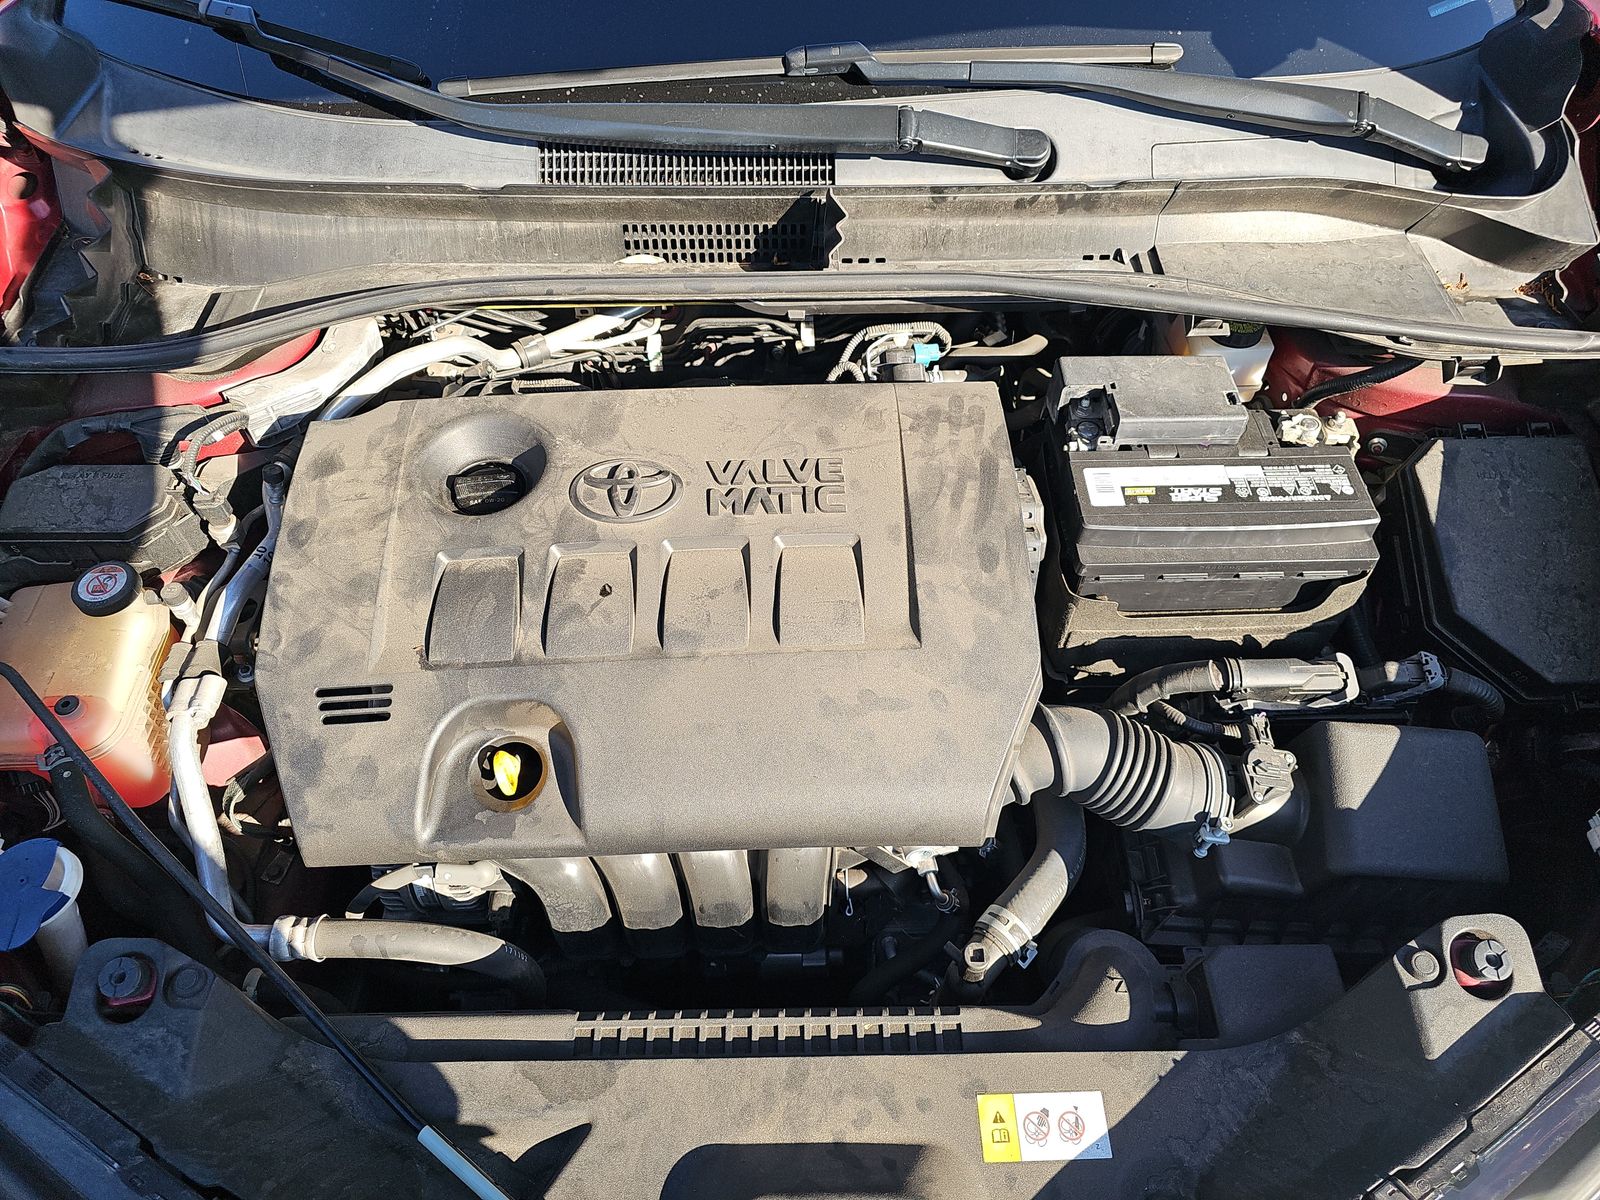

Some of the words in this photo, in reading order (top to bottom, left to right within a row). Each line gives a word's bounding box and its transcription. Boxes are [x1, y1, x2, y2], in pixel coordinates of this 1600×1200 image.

[101, 471, 126, 480] FUSE
[705, 457, 846, 486] VALVE
[705, 485, 848, 516] MATIC
[253, 545, 267, 559] 10
